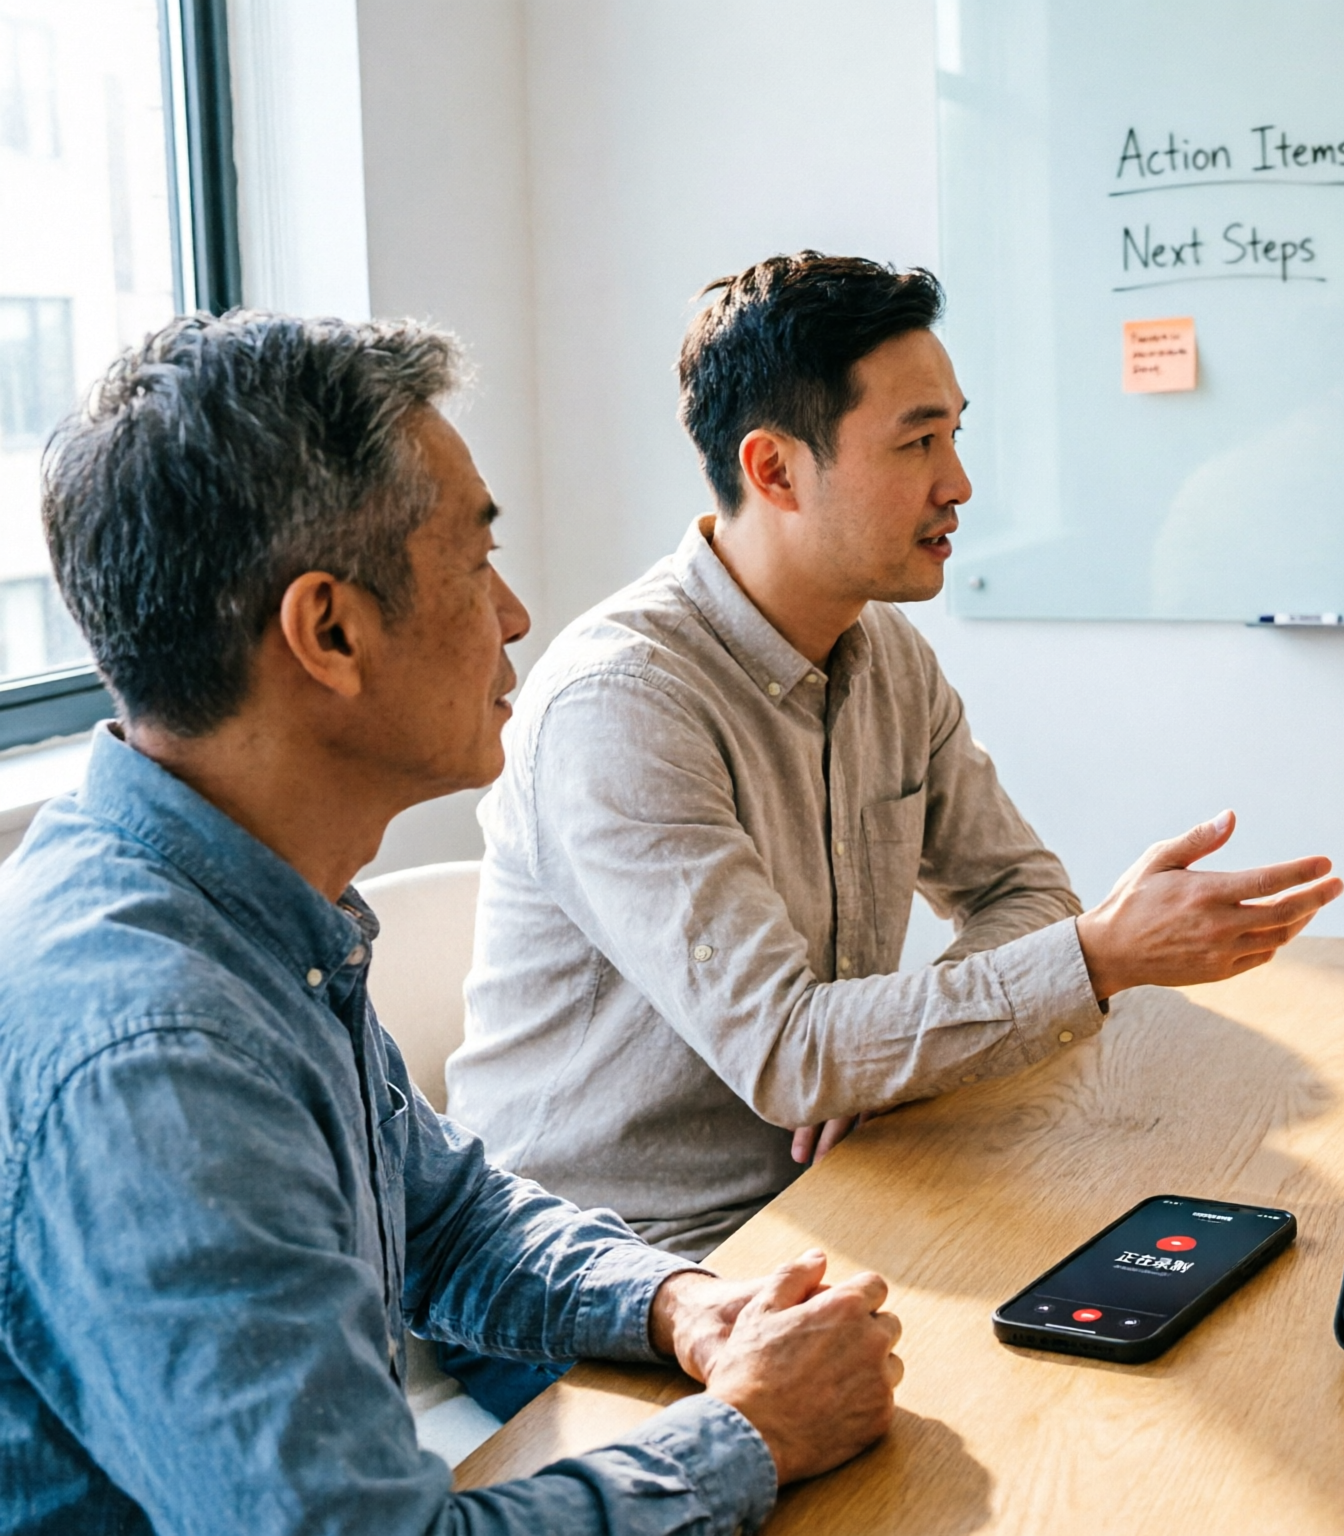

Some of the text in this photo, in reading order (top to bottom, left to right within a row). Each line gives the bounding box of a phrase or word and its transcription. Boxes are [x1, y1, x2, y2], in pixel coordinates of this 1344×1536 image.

[1117, 127, 1231, 178] Action
[1123, 221, 1316, 282] Next Steps
